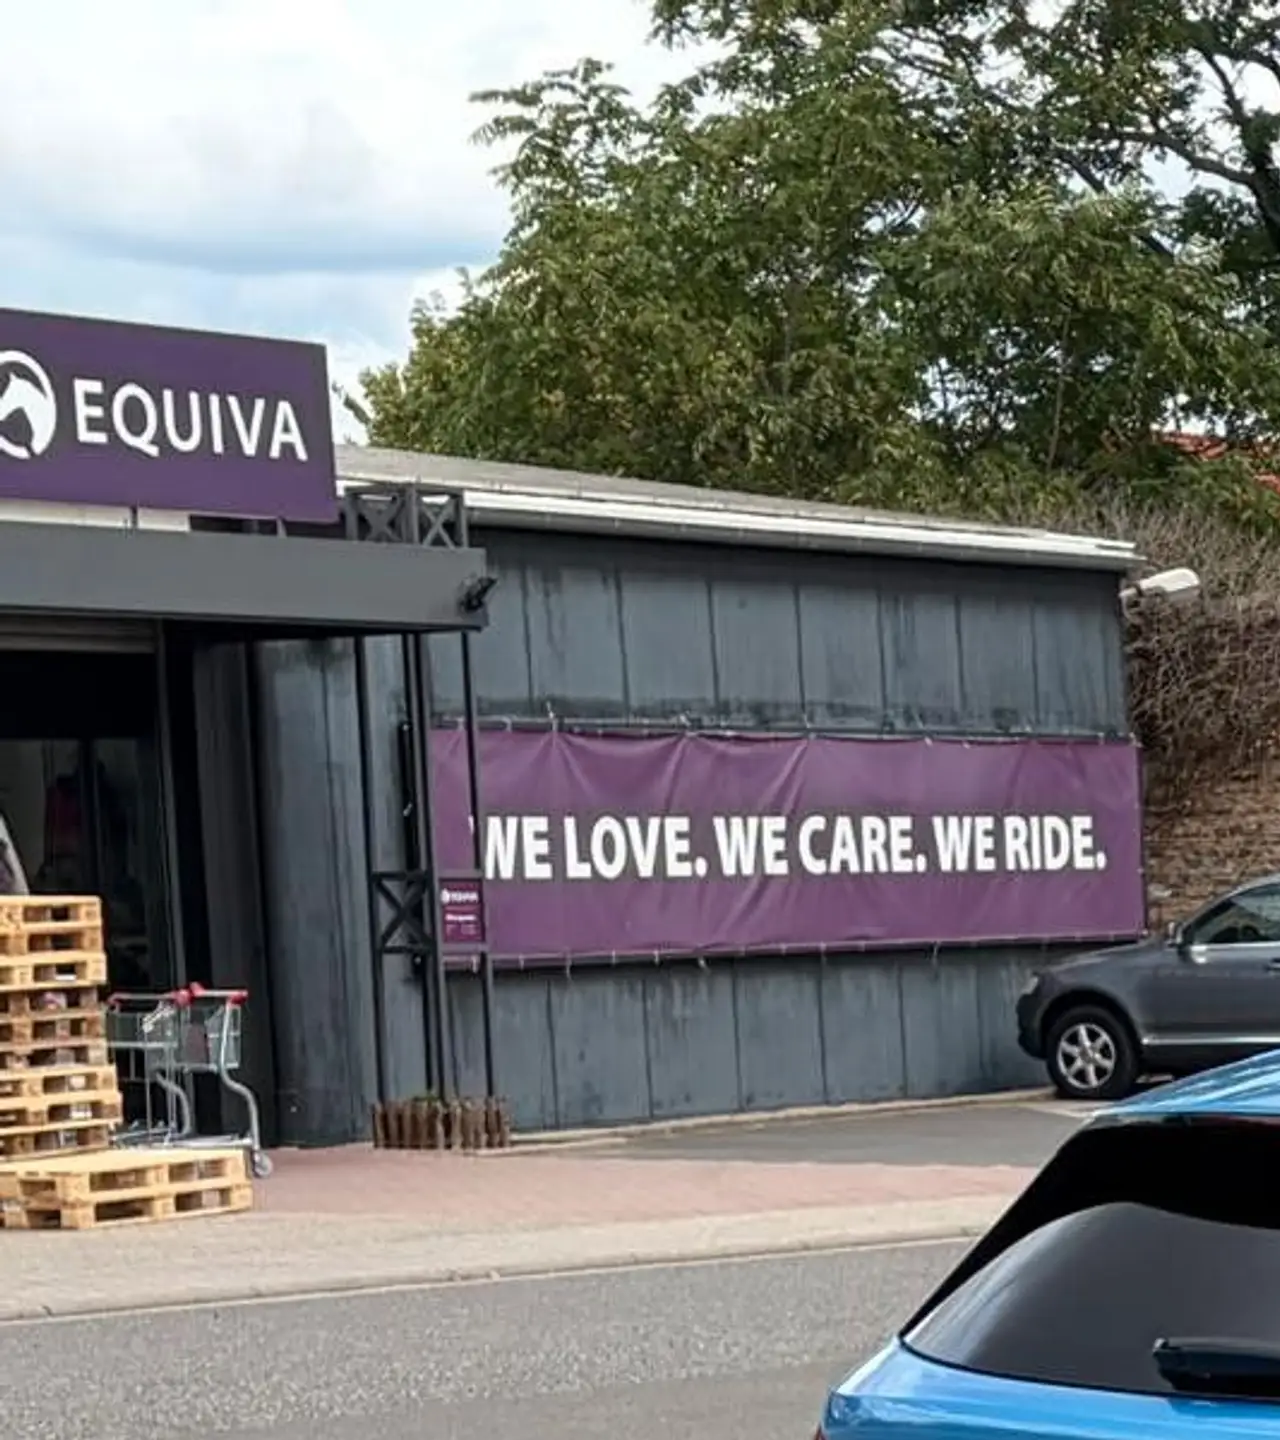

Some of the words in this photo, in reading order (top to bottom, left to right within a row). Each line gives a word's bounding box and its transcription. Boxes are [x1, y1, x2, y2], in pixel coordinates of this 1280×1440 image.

[72, 377, 309, 462] EQUIVA
[468, 815, 554, 880] WE
[562, 815, 707, 880] LOVE.
[713, 815, 790, 876] WE
[797, 814, 928, 874] CARE.
[931, 815, 997, 873] WE
[1002, 814, 1107, 872] RIDE.
